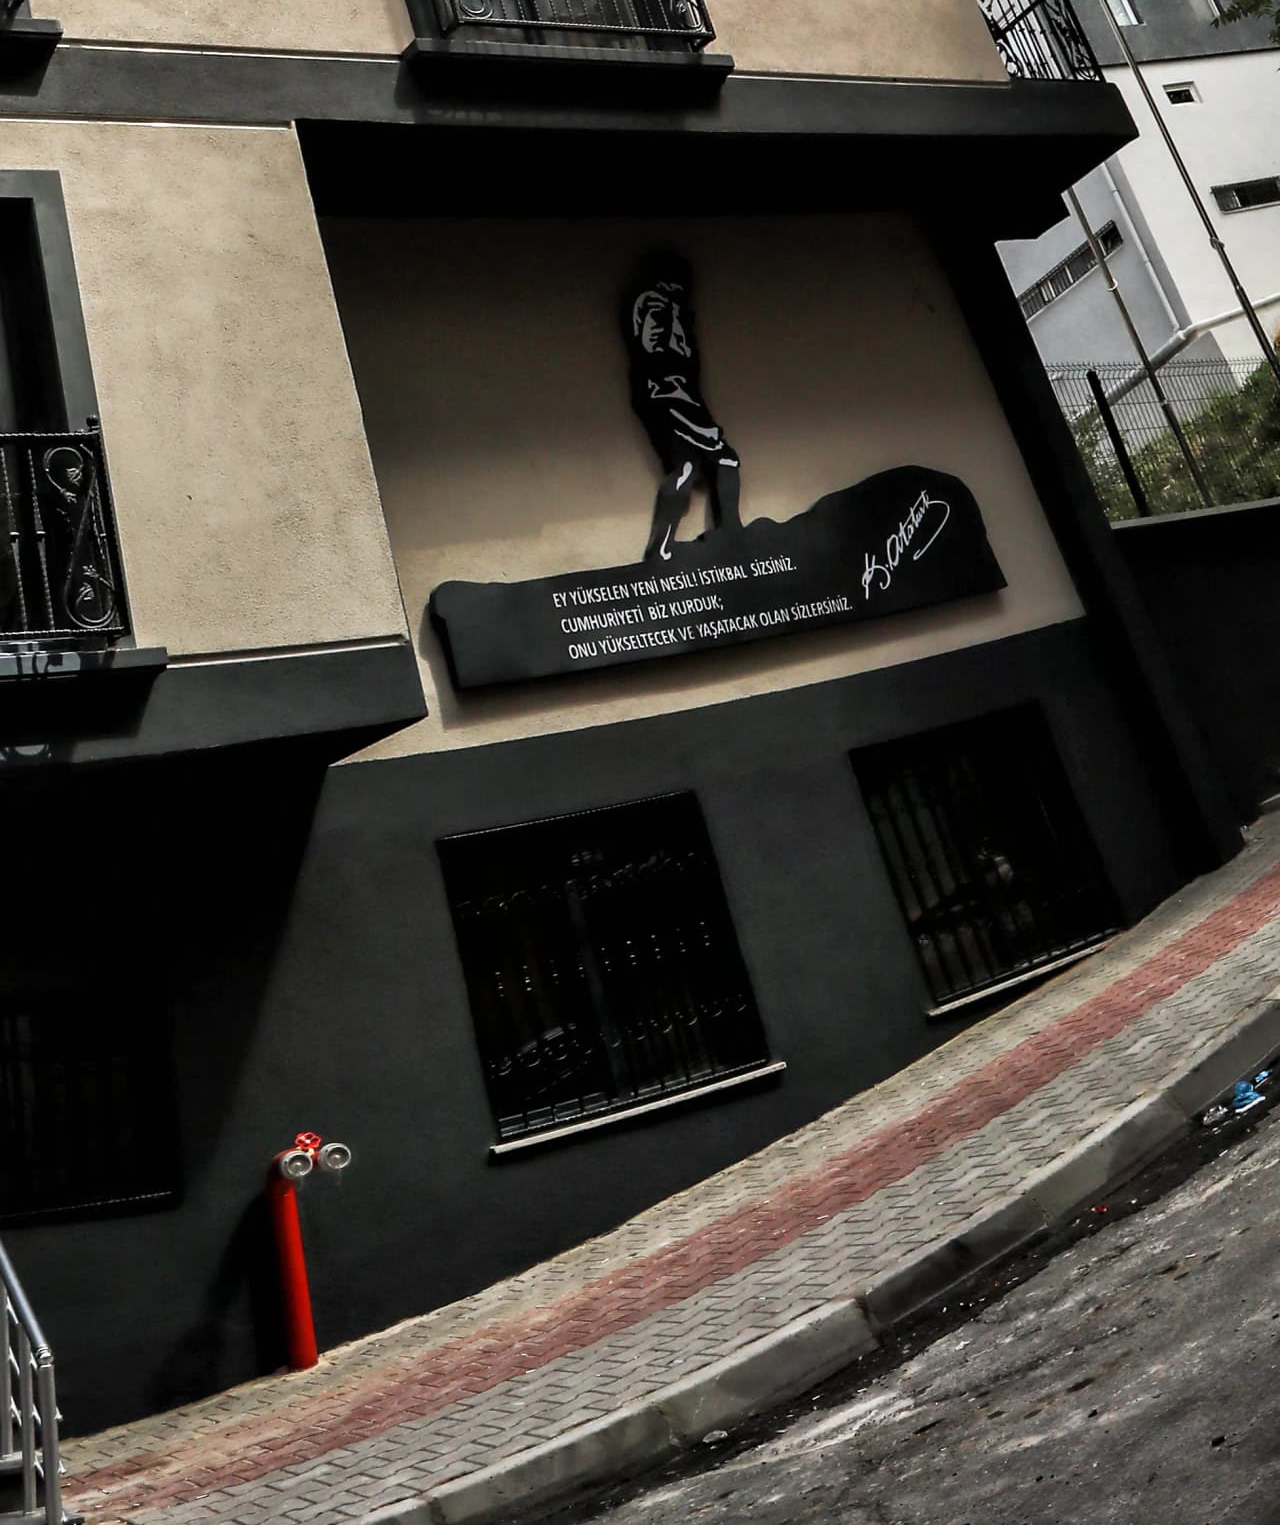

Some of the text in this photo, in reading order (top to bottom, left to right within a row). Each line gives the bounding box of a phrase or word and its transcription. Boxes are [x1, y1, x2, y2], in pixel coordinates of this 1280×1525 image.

[552, 555, 797, 608] EY YÜKSELEN YENİ NESİL! İSTİKBAL SİZSİNİZ.
[560, 595, 724, 634] CUMHURİYETİ BİZ KURDUK;
[568, 596, 853, 660] ONU YÜKSELTECEK VE YAŞATACAK OLAN SİZLERSİNİZ.
